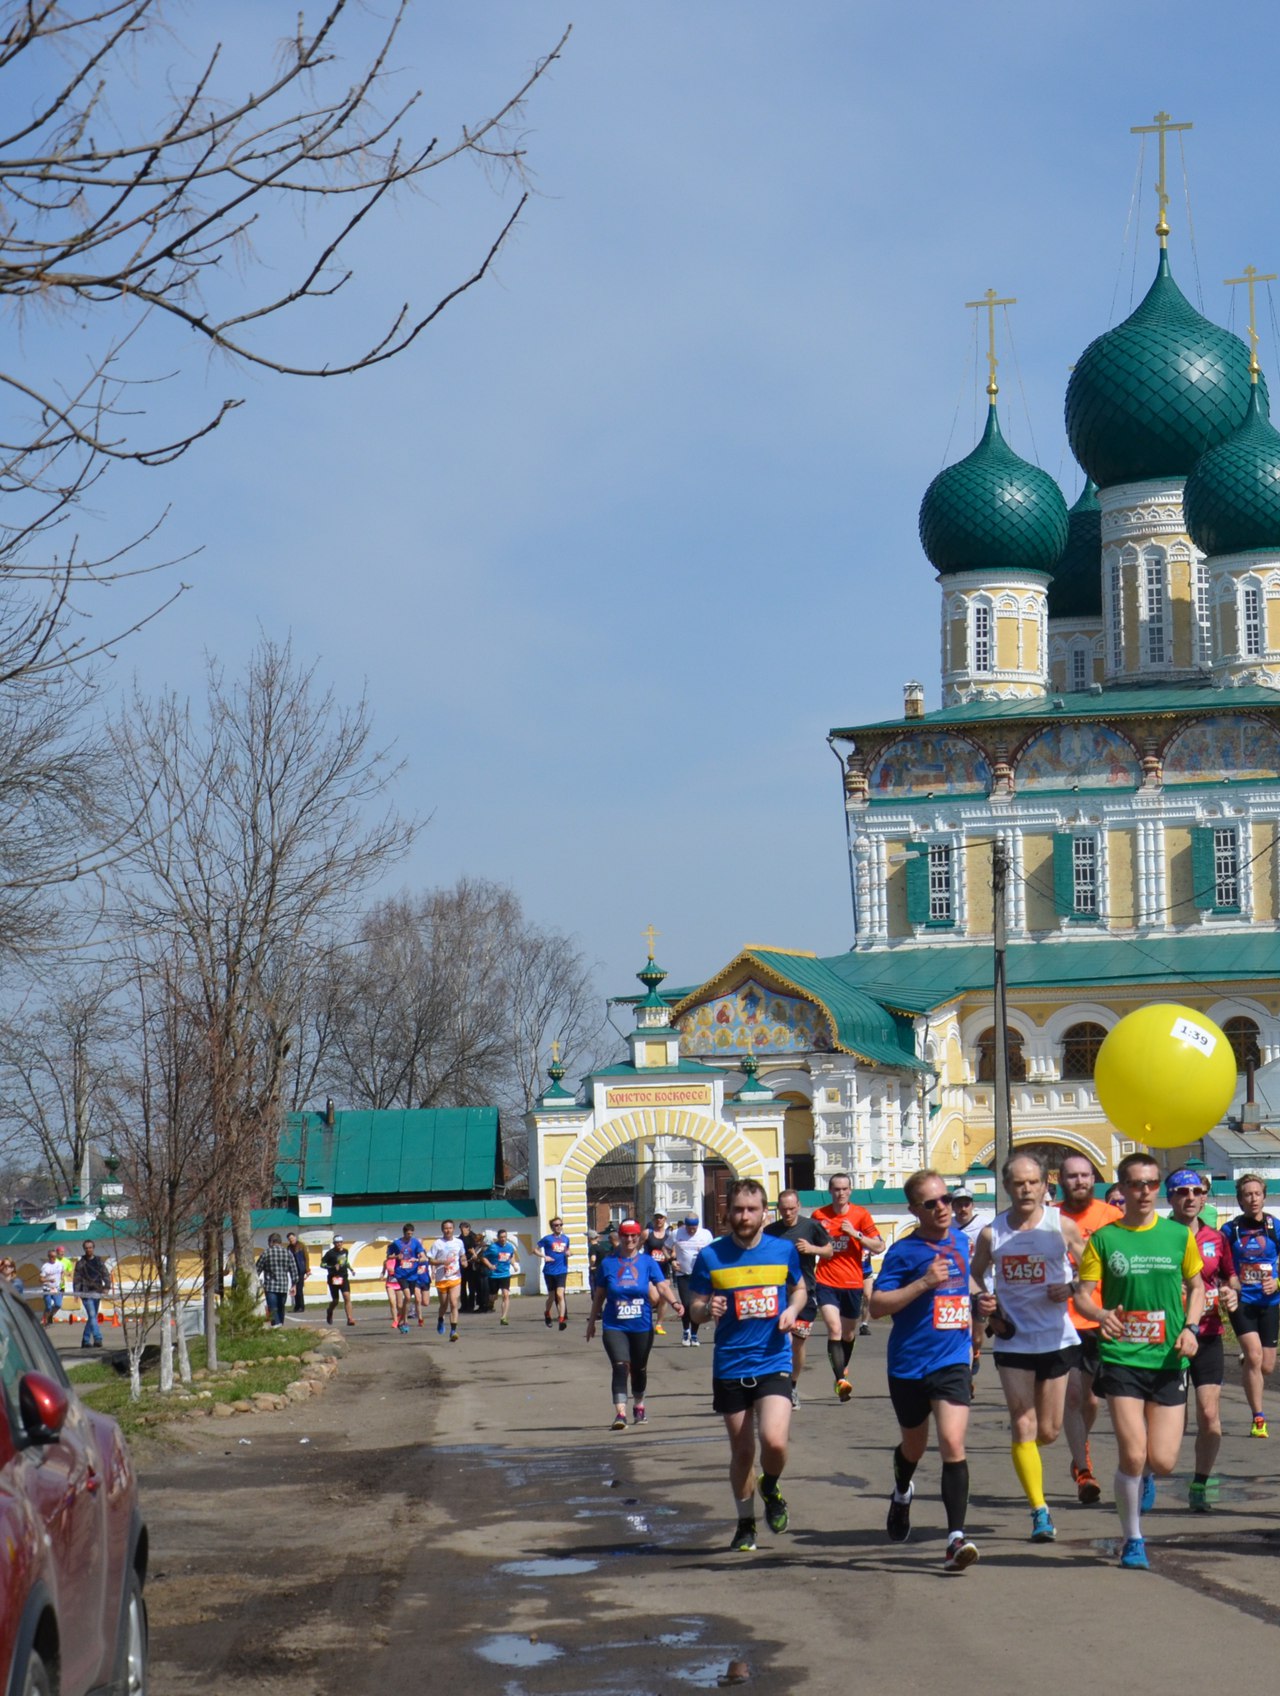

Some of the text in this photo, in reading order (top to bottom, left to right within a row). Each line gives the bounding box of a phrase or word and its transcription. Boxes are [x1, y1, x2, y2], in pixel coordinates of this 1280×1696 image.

[1180, 1025, 1208, 1046] 1:39
[1004, 1263, 1043, 1279] 3456
[618, 1305, 642, 1316] 2051
[740, 1297, 775, 1315] 3330
[1123, 1322, 1160, 1337] 3372
